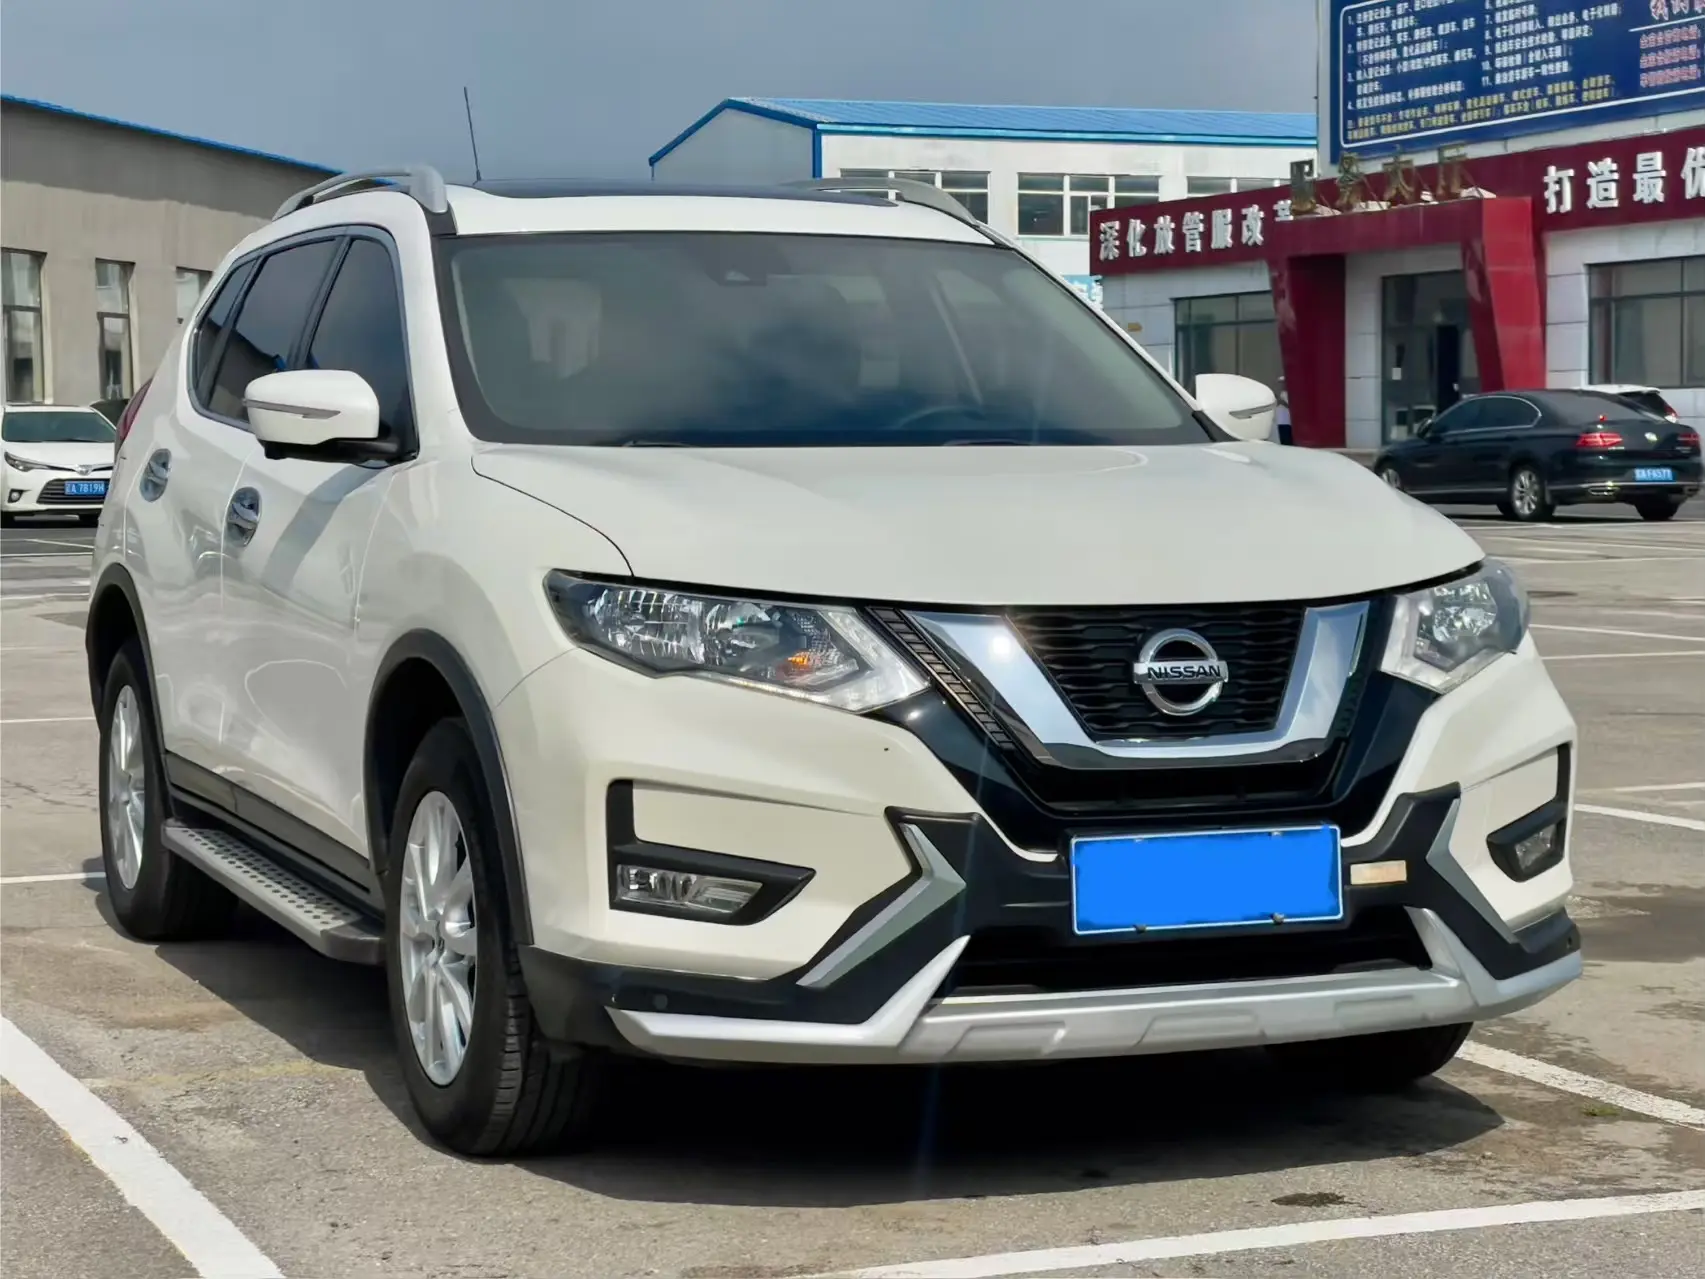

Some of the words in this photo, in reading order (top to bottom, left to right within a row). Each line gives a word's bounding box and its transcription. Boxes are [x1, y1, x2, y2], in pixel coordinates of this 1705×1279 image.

[1543, 146, 1705, 214] 打造最优
[1147, 665, 1221, 679] NISSAN
